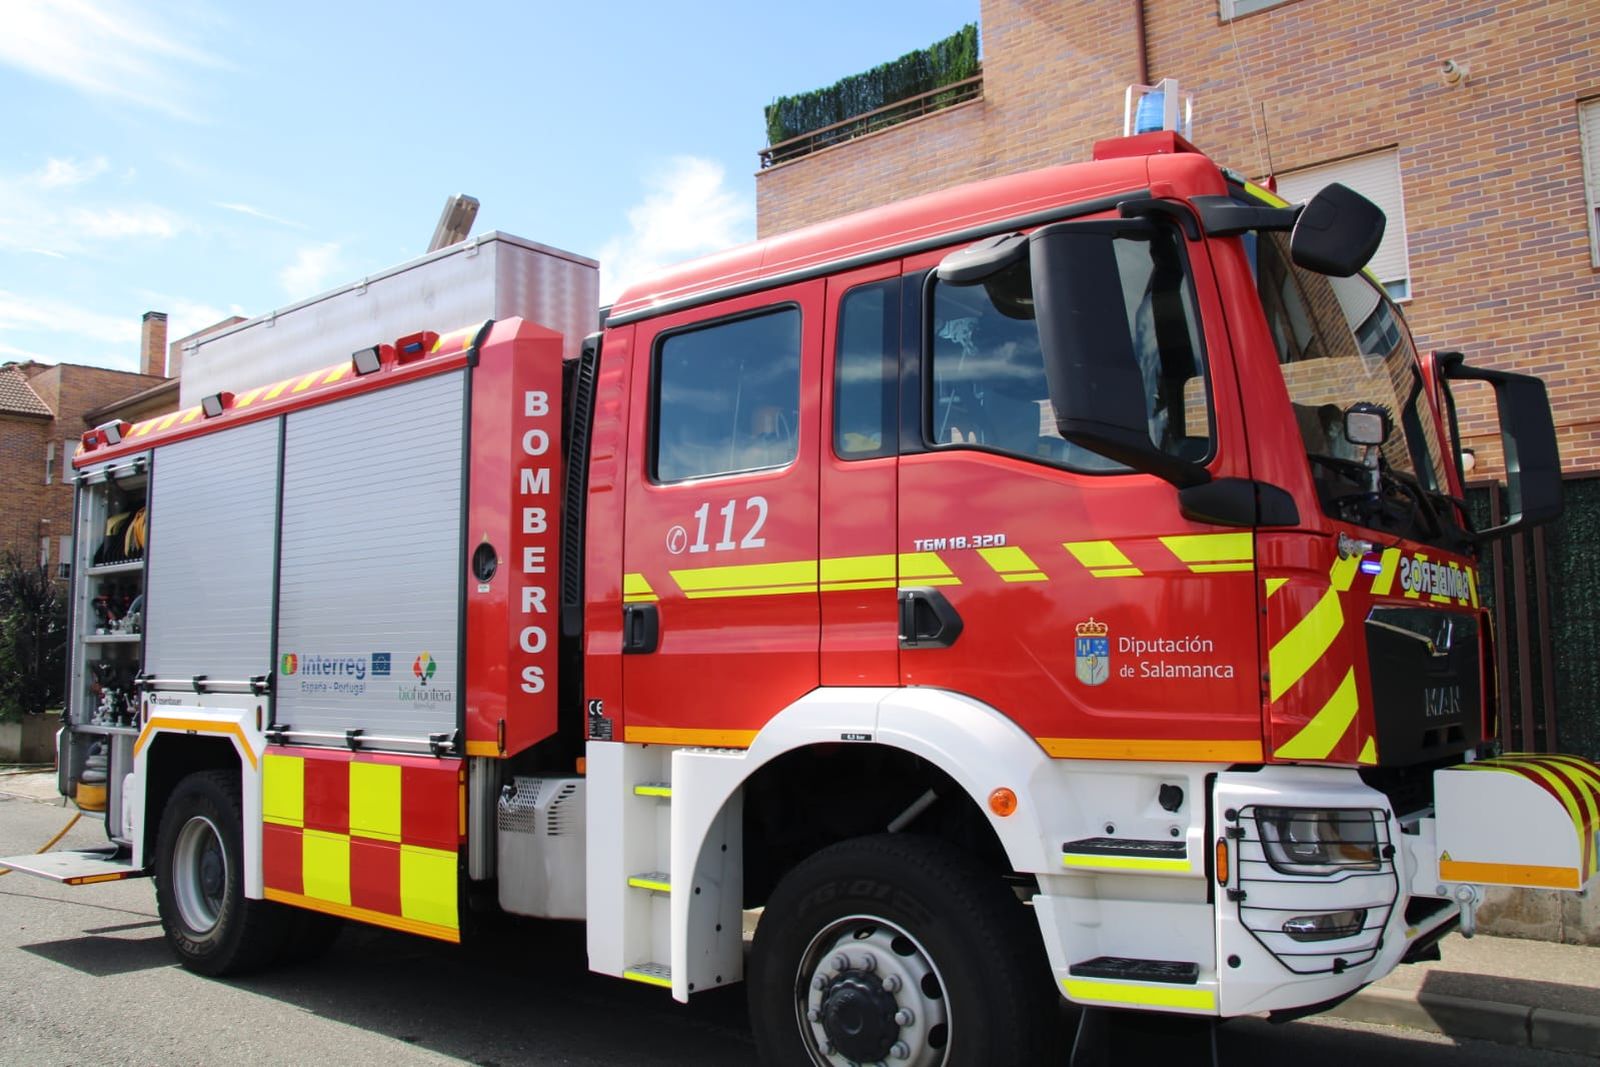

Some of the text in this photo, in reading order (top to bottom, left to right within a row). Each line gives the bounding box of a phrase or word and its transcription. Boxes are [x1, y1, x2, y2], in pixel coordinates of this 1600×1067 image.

[689, 495, 768, 555] 112
[519, 390, 550, 694] BOMBEROS
[914, 534, 1006, 552] TGM 18.320
[1118, 634, 1213, 658] Diputación
[302, 654, 366, 680] Interreg
[1119, 660, 1234, 680] de Salamanca
[301, 681, 327, 694] España
[334, 682, 366, 697] Portugal
[588, 701, 604, 716] CE
